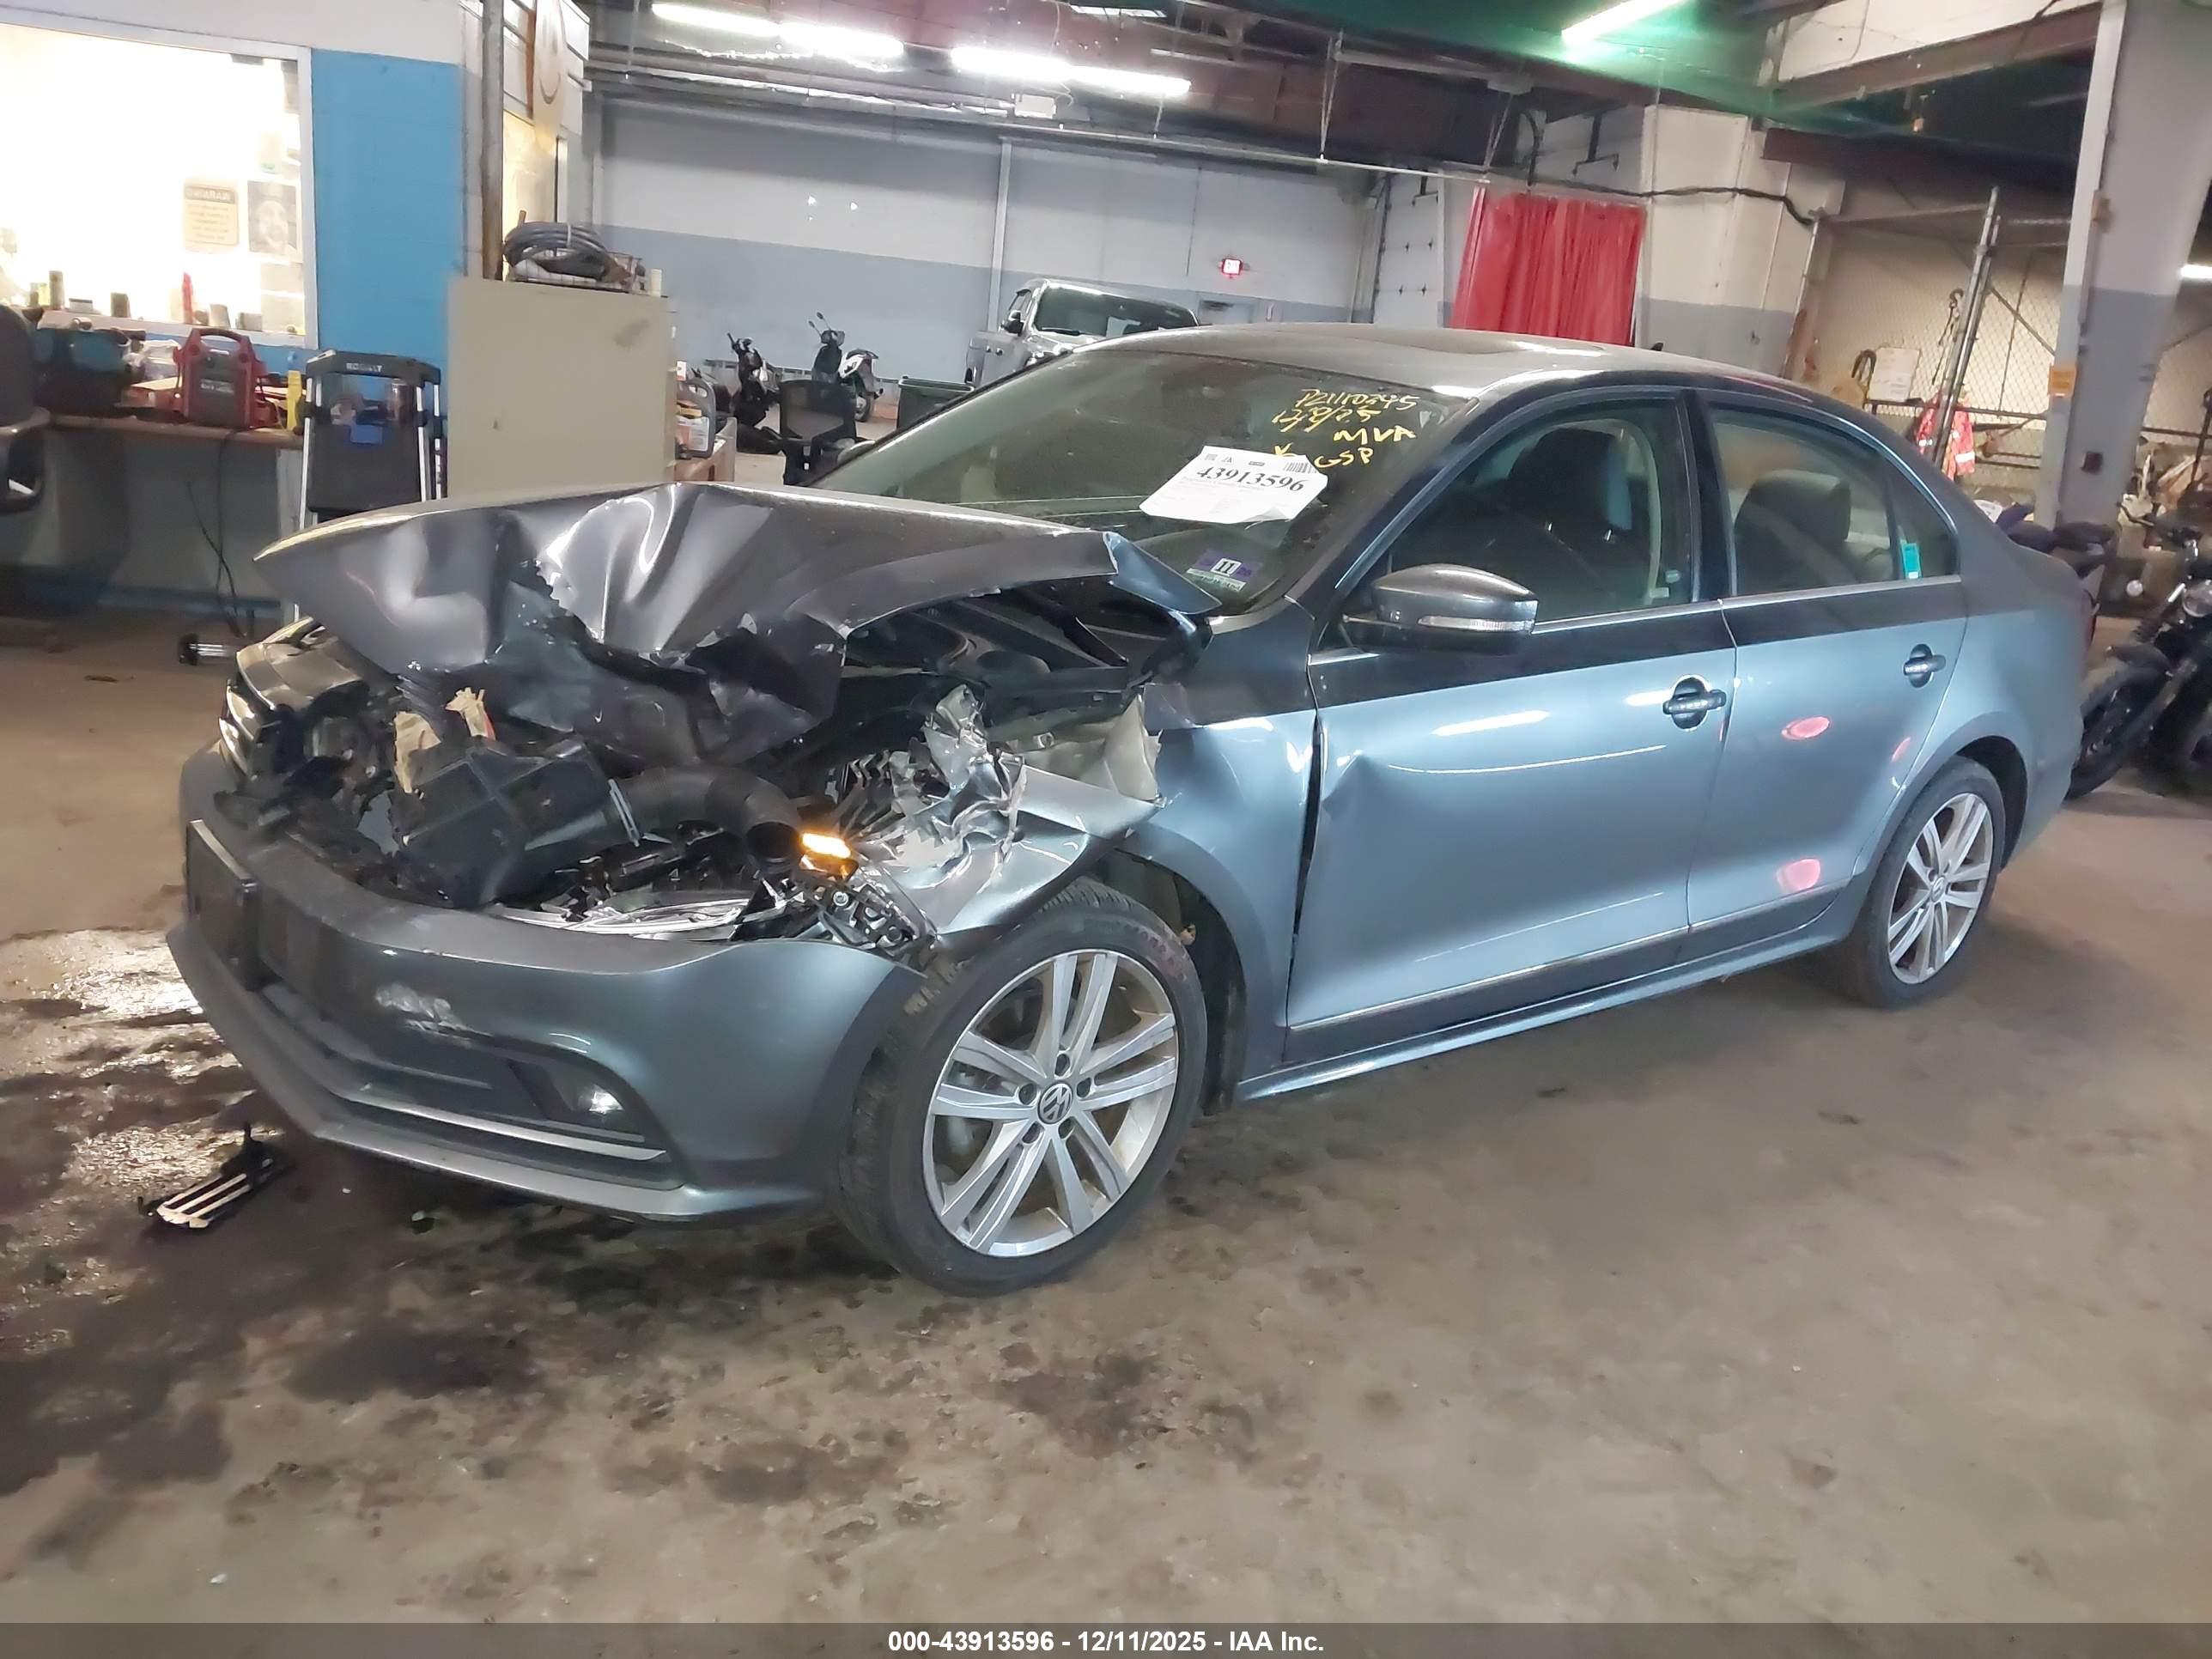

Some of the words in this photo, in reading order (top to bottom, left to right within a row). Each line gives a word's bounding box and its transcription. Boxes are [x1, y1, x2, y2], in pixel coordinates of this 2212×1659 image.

[1333, 425, 1417, 445] MVA
[1314, 447, 1374, 468] GSP
[1196, 466, 1308, 492] 43913596
[1215, 561, 1235, 574] 11
